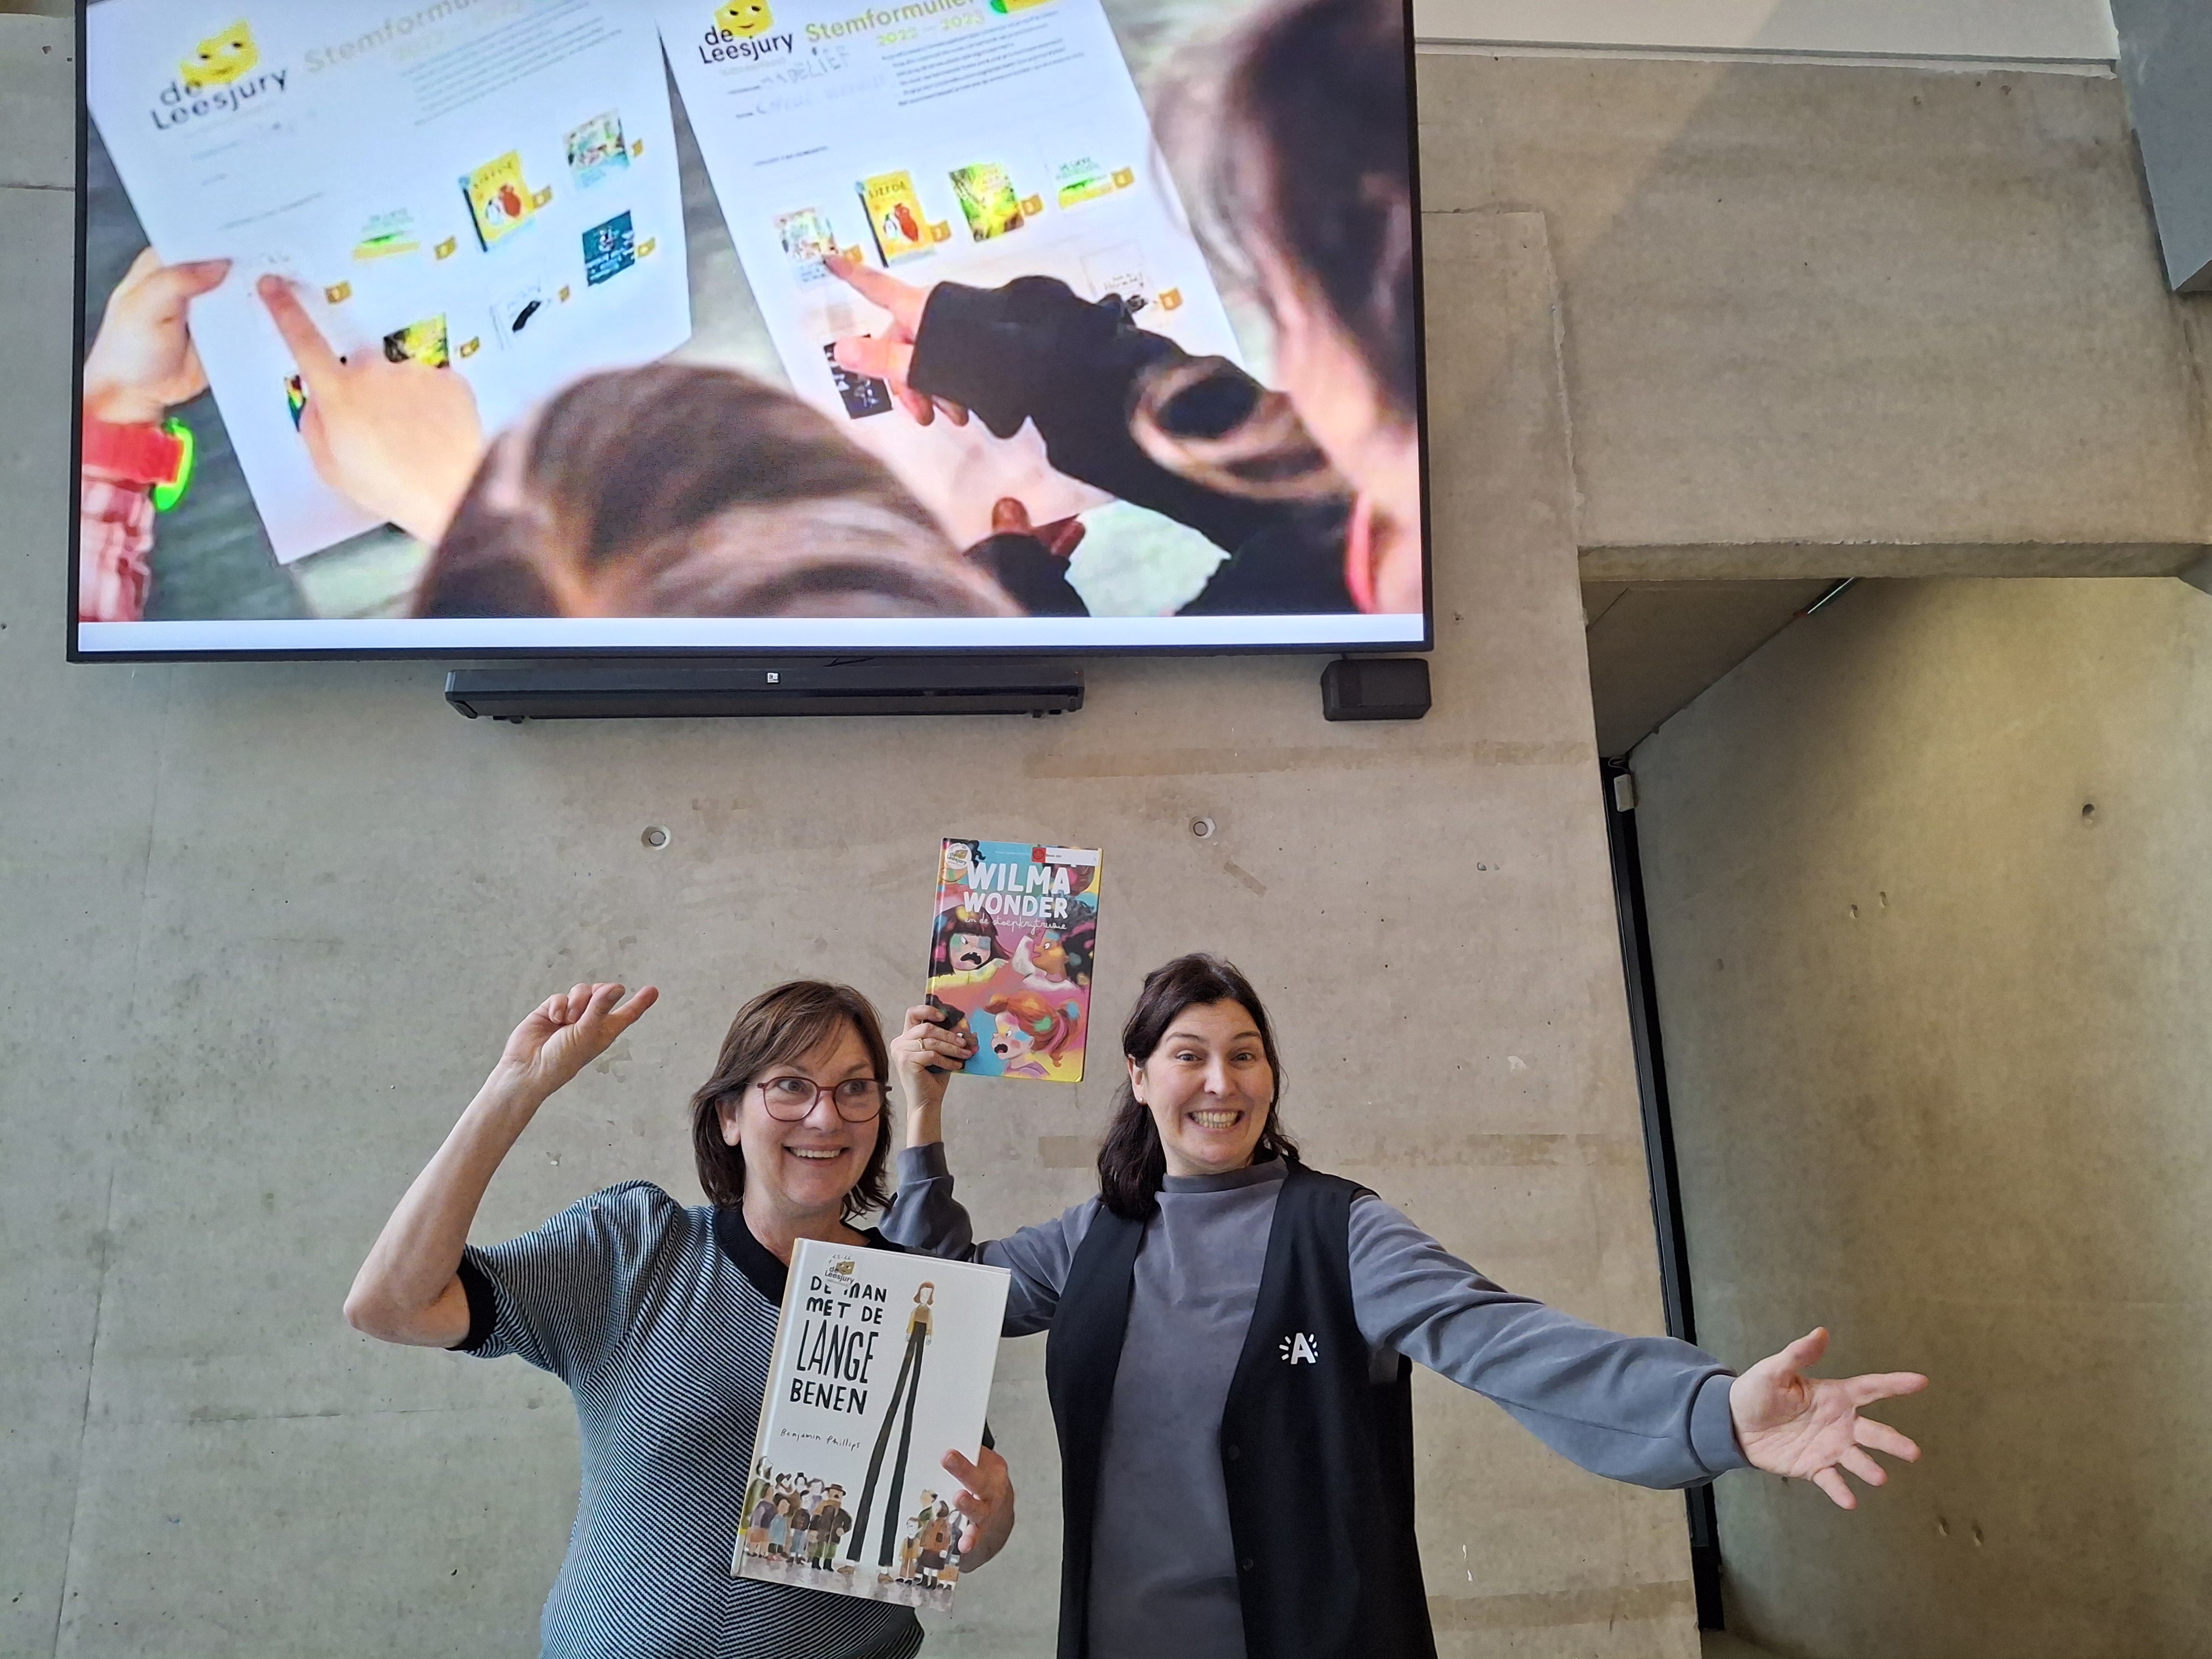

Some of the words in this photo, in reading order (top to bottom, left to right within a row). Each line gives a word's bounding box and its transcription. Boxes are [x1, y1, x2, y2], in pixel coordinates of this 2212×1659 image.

[304, 0, 478, 73] Stemformu
[698, 33, 793, 64] Leesjury
[704, 24, 734, 46] de
[150, 68, 286, 131] Leesjury
[159, 79, 202, 107] de
[967, 861, 1071, 895] WILMA
[963, 891, 1069, 919] WONDER
[979, 912, 989, 924] de
[809, 1275, 832, 1295] DE
[843, 1282, 888, 1303] MAN
[825, 1269, 855, 1285] Leesjury
[806, 1296, 852, 1319] MET
[860, 1305, 884, 1325] DE
[796, 1319, 879, 1384] LANGE
[1290, 1332, 1316, 1365] A
[789, 1377, 868, 1415] BENEN
[780, 1427, 821, 1442] Benjamin
[826, 1435, 861, 1452] Phillips
